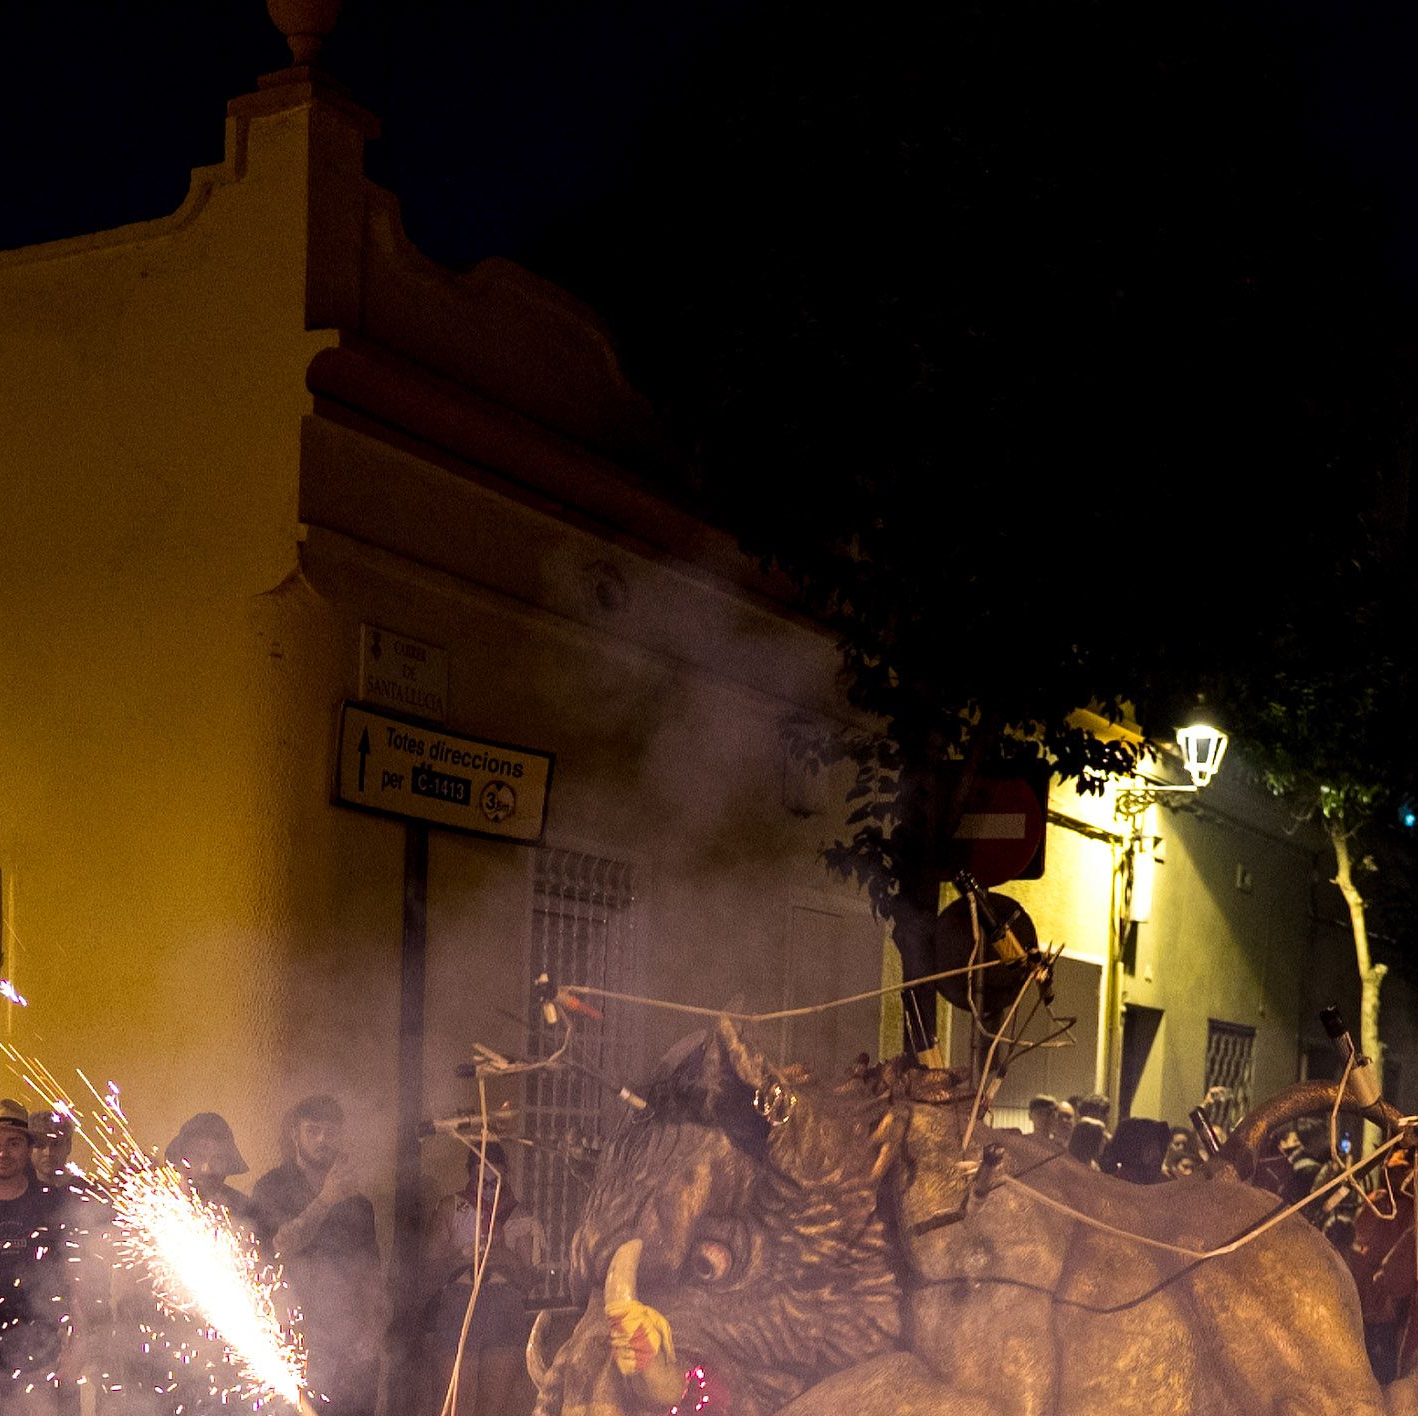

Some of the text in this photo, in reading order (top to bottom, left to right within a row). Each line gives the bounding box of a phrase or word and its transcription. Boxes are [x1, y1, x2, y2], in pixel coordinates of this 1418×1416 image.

[368, 676, 403, 702] SANTA
[387, 726, 523, 778] Totes direccions
[381, 770, 465, 801] per C-1413
